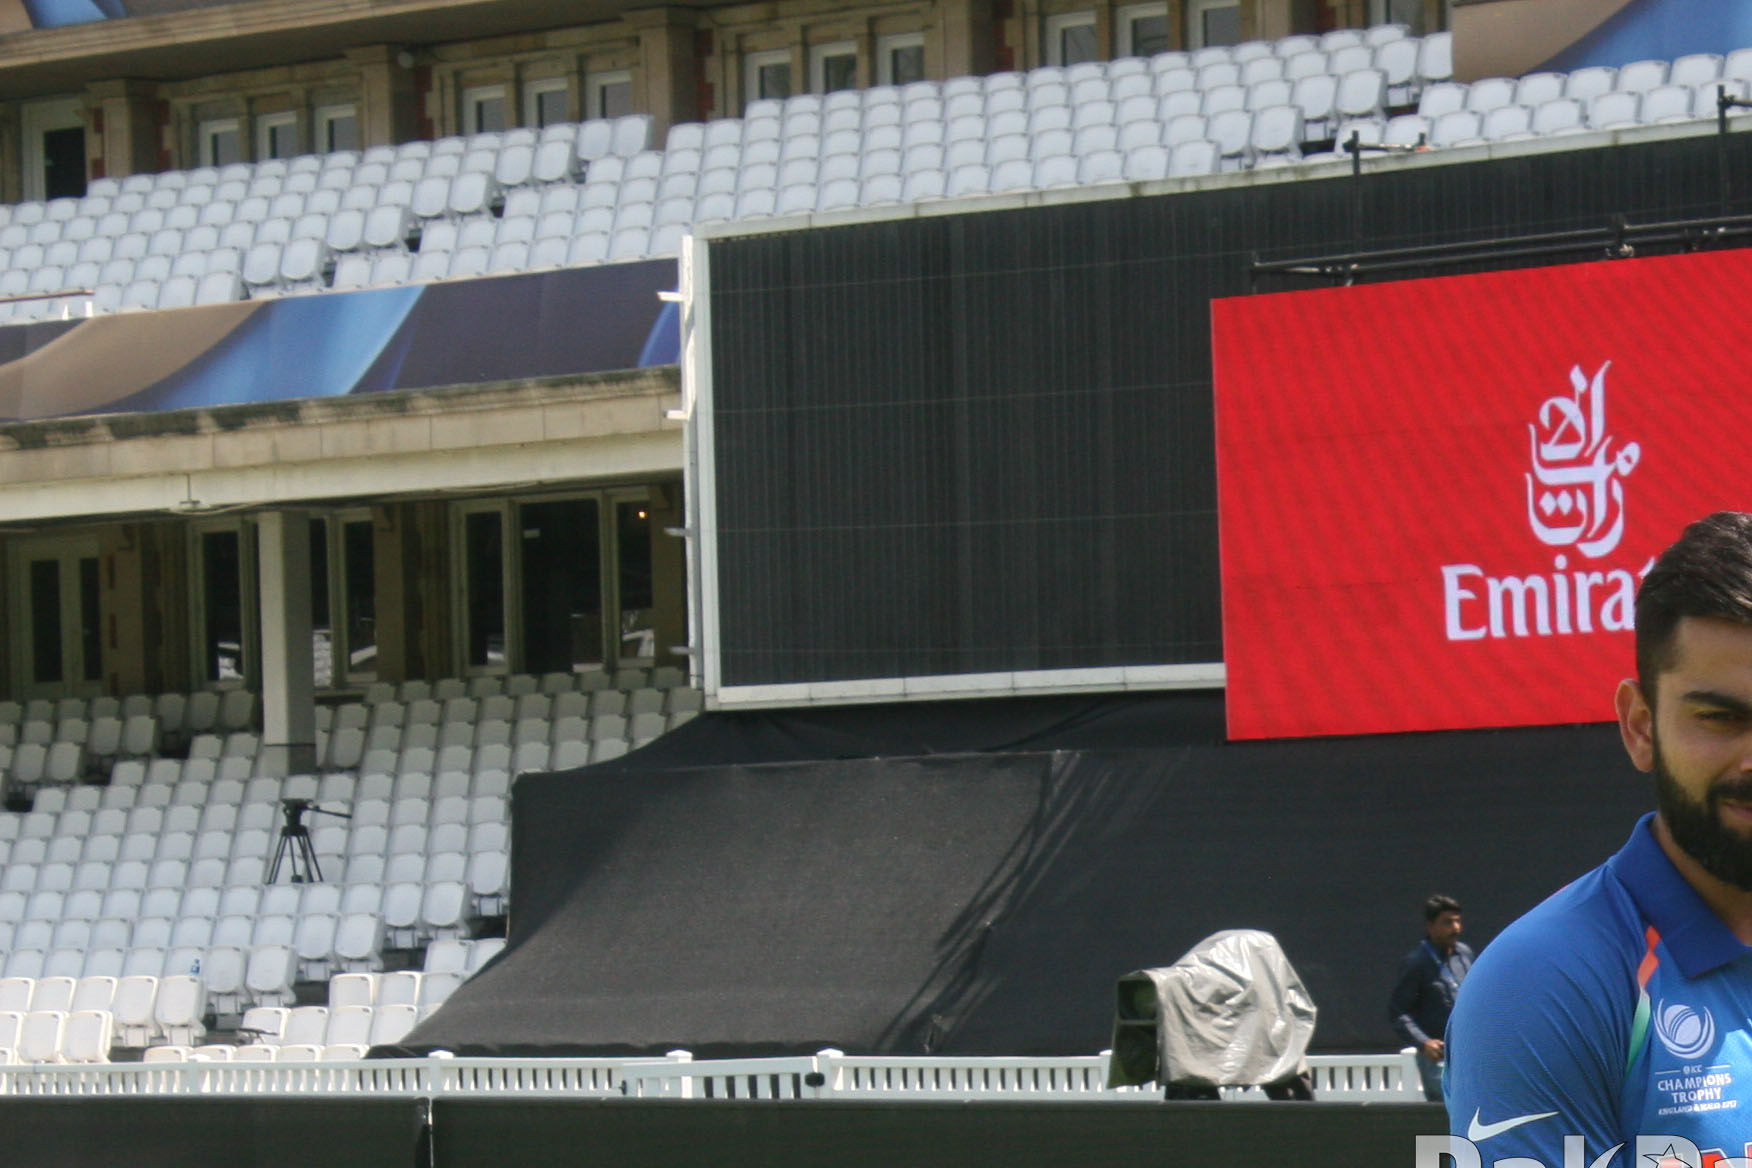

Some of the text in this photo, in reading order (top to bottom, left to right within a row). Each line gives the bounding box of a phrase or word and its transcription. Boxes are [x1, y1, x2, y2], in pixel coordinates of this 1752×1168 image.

[1440, 554, 1657, 641] Emira
[1657, 1072, 1733, 1092] CHAMPIONS
[1671, 1087, 1722, 1104] TROPHY
